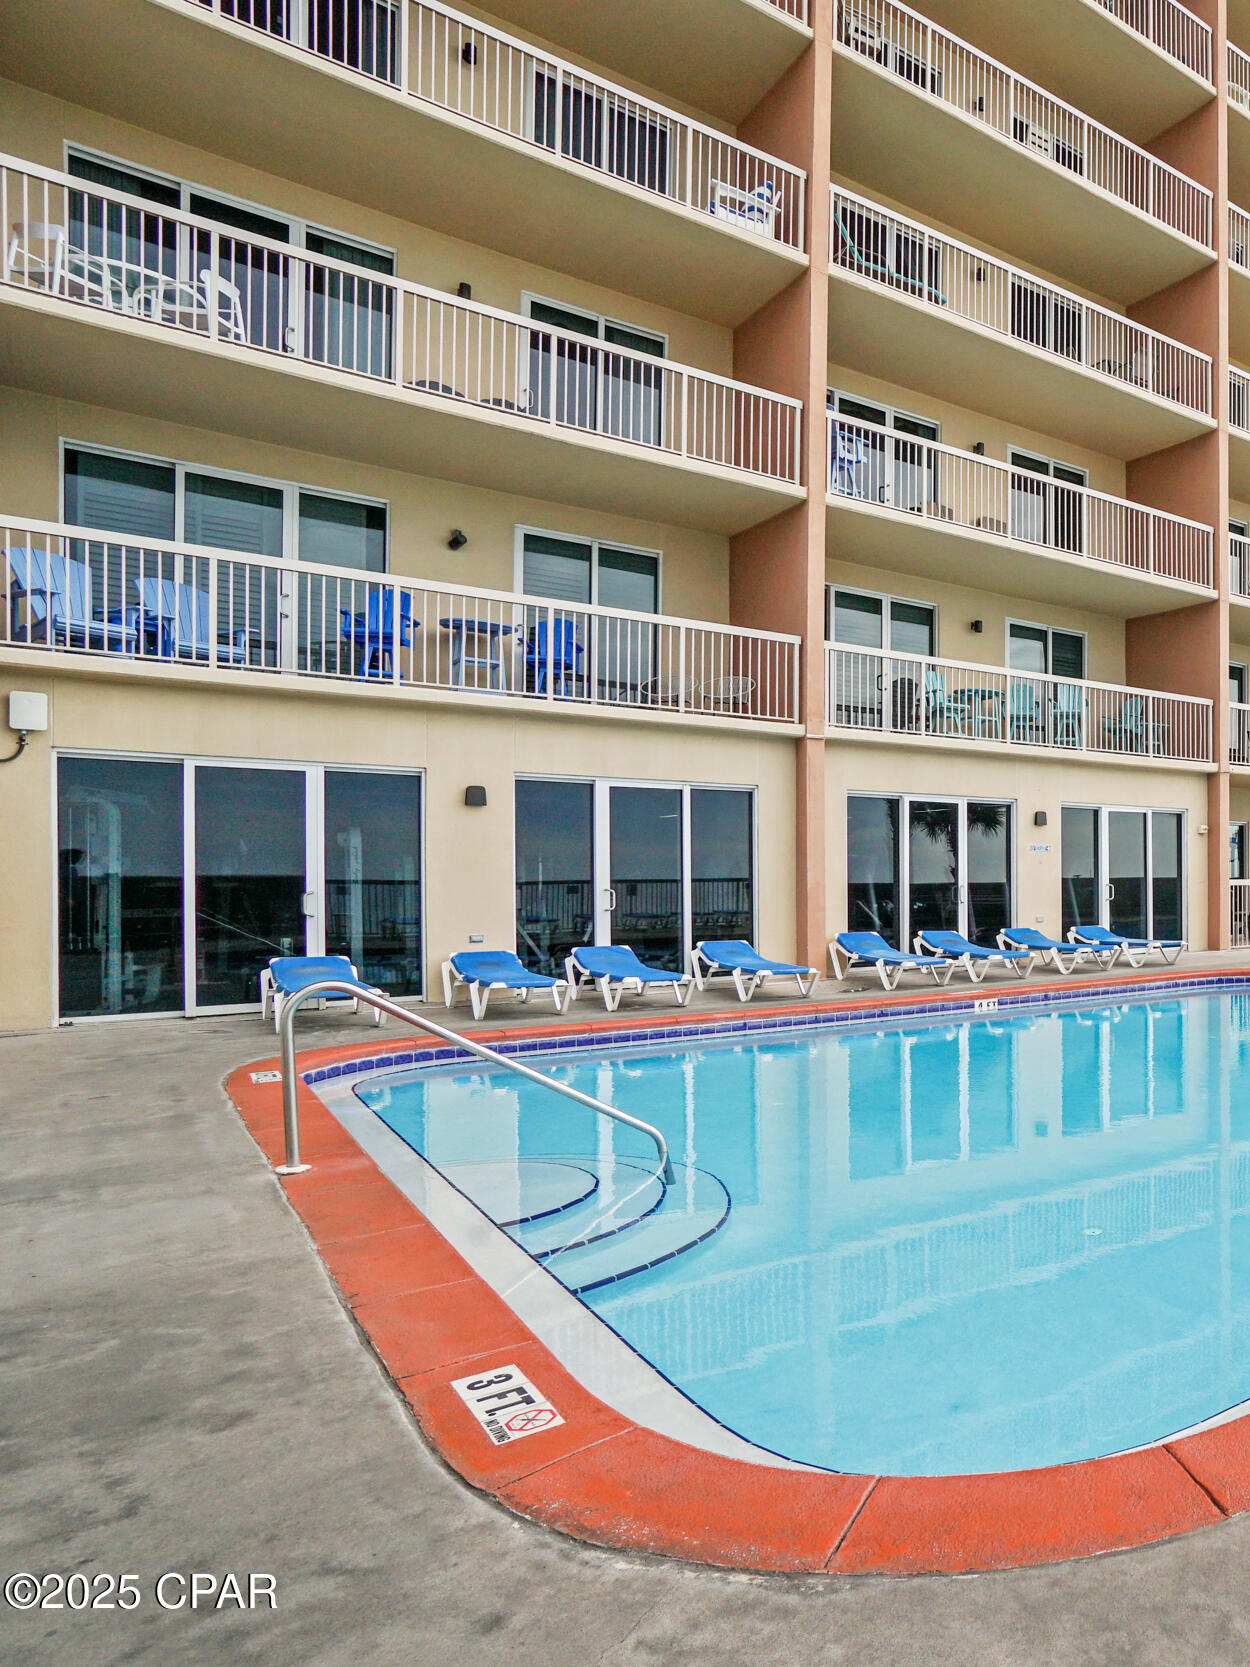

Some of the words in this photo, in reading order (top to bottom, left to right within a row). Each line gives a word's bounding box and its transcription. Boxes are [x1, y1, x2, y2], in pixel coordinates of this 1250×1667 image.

[466, 1373, 513, 1391] 3
[476, 1386, 536, 1417] FT.
[484, 1418, 500, 1428] NO
